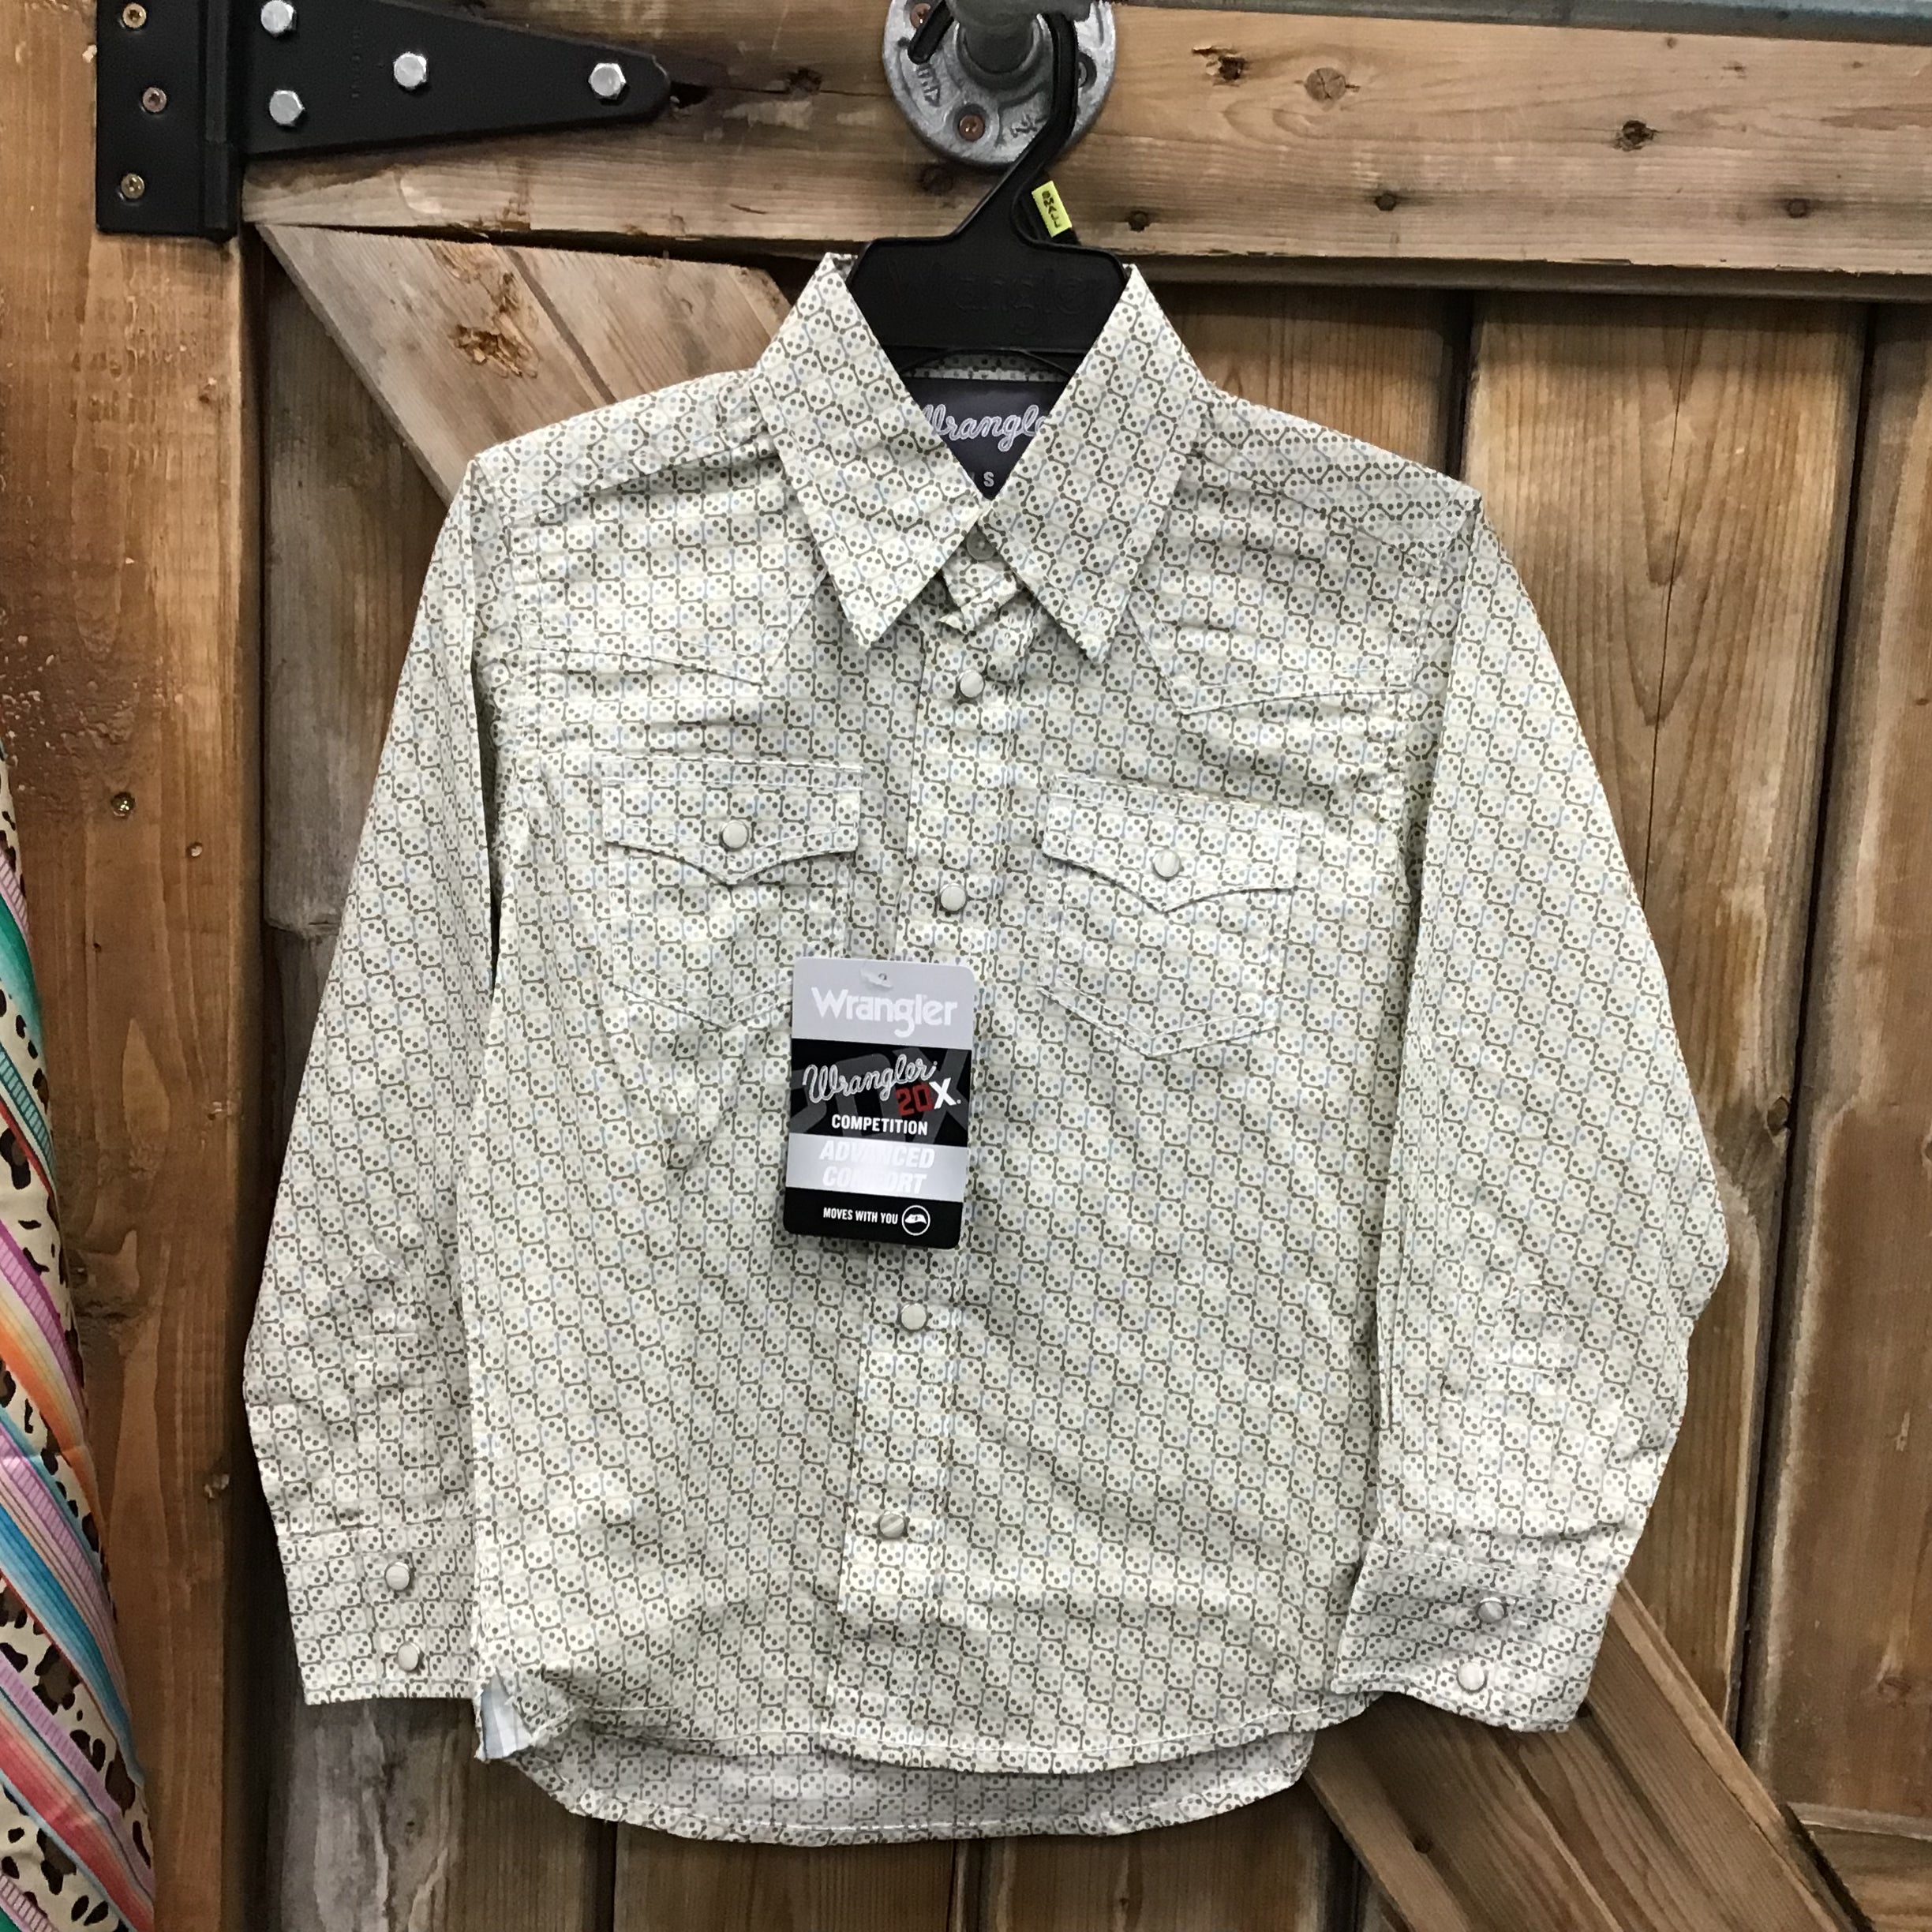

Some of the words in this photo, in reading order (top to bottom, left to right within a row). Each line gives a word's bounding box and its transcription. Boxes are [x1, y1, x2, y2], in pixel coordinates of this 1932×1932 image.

[1042, 191, 1061, 228] SMALL
[983, 472, 994, 487] S
[811, 987, 957, 1038] Wrangler
[802, 1054, 938, 1103] Wrangler
[831, 1114, 928, 1136] COMPETITION
[818, 1140, 935, 1169] ADVANCED
[822, 1166, 927, 1194] COORT
[823, 1207, 853, 1221] MOVES
[855, 1210, 878, 1223] WITH
[880, 1212, 899, 1225] YOU
